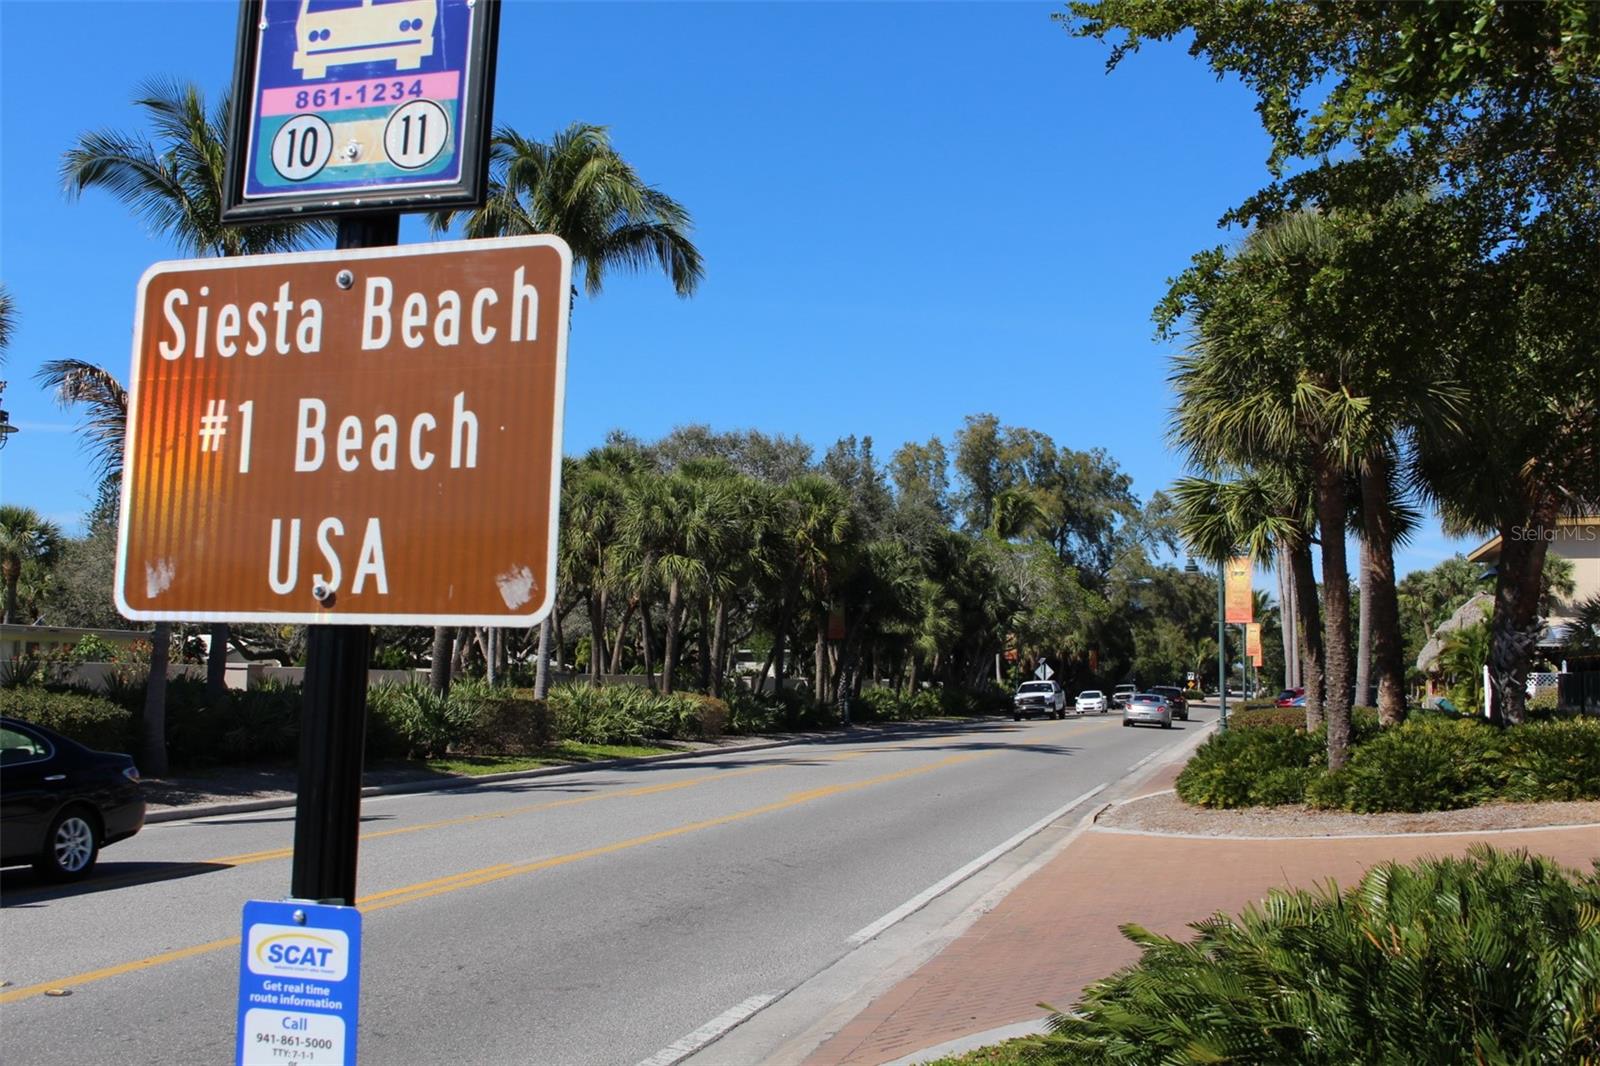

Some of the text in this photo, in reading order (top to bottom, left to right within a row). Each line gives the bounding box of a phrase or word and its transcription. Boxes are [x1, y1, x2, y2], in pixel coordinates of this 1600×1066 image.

[295, 79, 424, 109] 861-1234
[287, 126, 318, 168] 10
[402, 114, 427, 156] 11
[158, 265, 540, 360] Siesta Beach
[198, 391, 478, 473] #1 Beach
[268, 516, 389, 596] USA
[268, 943, 333, 967] SCAT
[250, 993, 342, 1009] route information
[263, 980, 330, 996] Get real time
[282, 1017, 307, 1031] Call
[256, 1033, 333, 1050] 941-861-5000
[272, 1048, 314, 1060] TTY: 7-1-1
